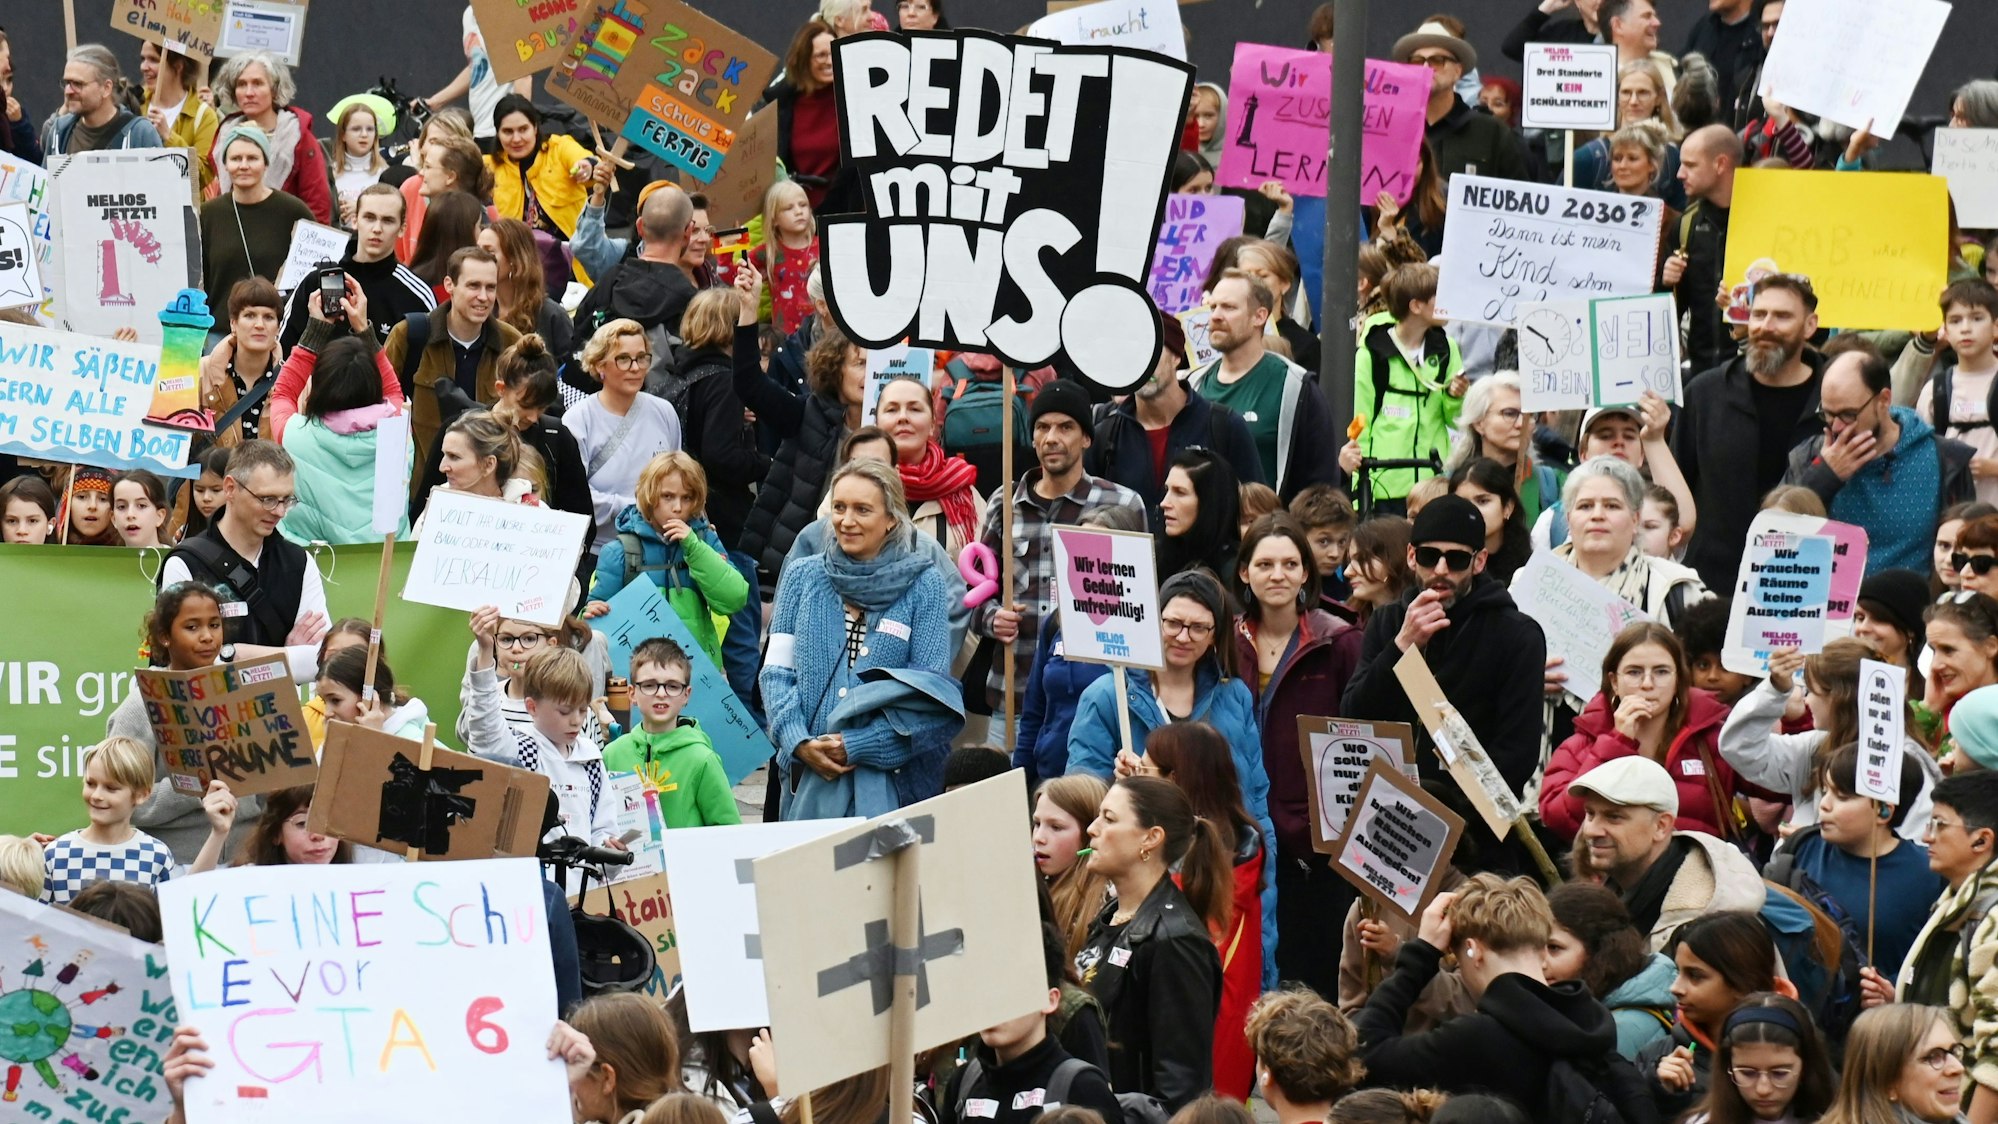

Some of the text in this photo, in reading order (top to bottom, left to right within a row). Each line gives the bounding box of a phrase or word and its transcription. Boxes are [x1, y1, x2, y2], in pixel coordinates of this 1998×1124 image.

[1261, 60, 1308, 88] Wir
[1536, 68, 1602, 78] Drei Standorte
[1556, 83, 1582, 93] KEIN
[840, 36, 1109, 168] REDET
[1530, 96, 1608, 109] SCHÜLERTICKET!
[87, 193, 147, 207] HELIOS
[870, 162, 1022, 225] mit
[101, 206, 157, 221] JETZT!
[1463, 185, 1648, 228] NEUBAU 2030?
[1488, 217, 1622, 252] Dann ist mein
[1478, 242, 1613, 293] Kind schon
[71, 346, 157, 393] SÄßEN
[889, 359, 907, 368] Wir
[64, 389, 127, 416] ALLE
[31, 415, 122, 455] SELBEN
[1762, 539, 1785, 548] JETZT!
[1774, 549, 1799, 559] Wir
[1073, 556, 1136, 579] Wir lernen
[1750, 562, 1820, 575] brauchen
[1082, 577, 1125, 597] Geduld
[1759, 577, 1809, 589] Räume
[1763, 592, 1803, 603] keine
[639, 592, 662, 624] Ihr
[1073, 596, 1145, 623] unfreiwillig!
[1746, 606, 1821, 618] Ausreden!
[611, 619, 633, 650] Ihr
[1095, 631, 1125, 645] HELIOS
[1761, 631, 1798, 639] HELIOS
[1102, 643, 1130, 657] JETZT!
[1769, 639, 1802, 647] JETZT!
[250, 665, 271, 675] HELIOS
[250, 673, 273, 683] JETZT!
[1870, 693, 1891, 706] sollen
[1881, 711, 1892, 722] all
[1338, 729, 1360, 737] JETZT!
[1867, 737, 1891, 752] Kinder
[205, 730, 312, 783] RÄUME
[1333, 756, 1370, 768] solle
[1333, 770, 1360, 780] nur
[1394, 800, 1418, 823] Wir
[1370, 798, 1432, 849] brauchen
[1373, 816, 1418, 854] Räume
[1372, 830, 1409, 861] keine
[1355, 833, 1422, 885] Ausreden!
[1361, 862, 1395, 889] HELIOS
[192, 889, 386, 958] KEINE
[228, 995, 509, 1084] GTA 6
